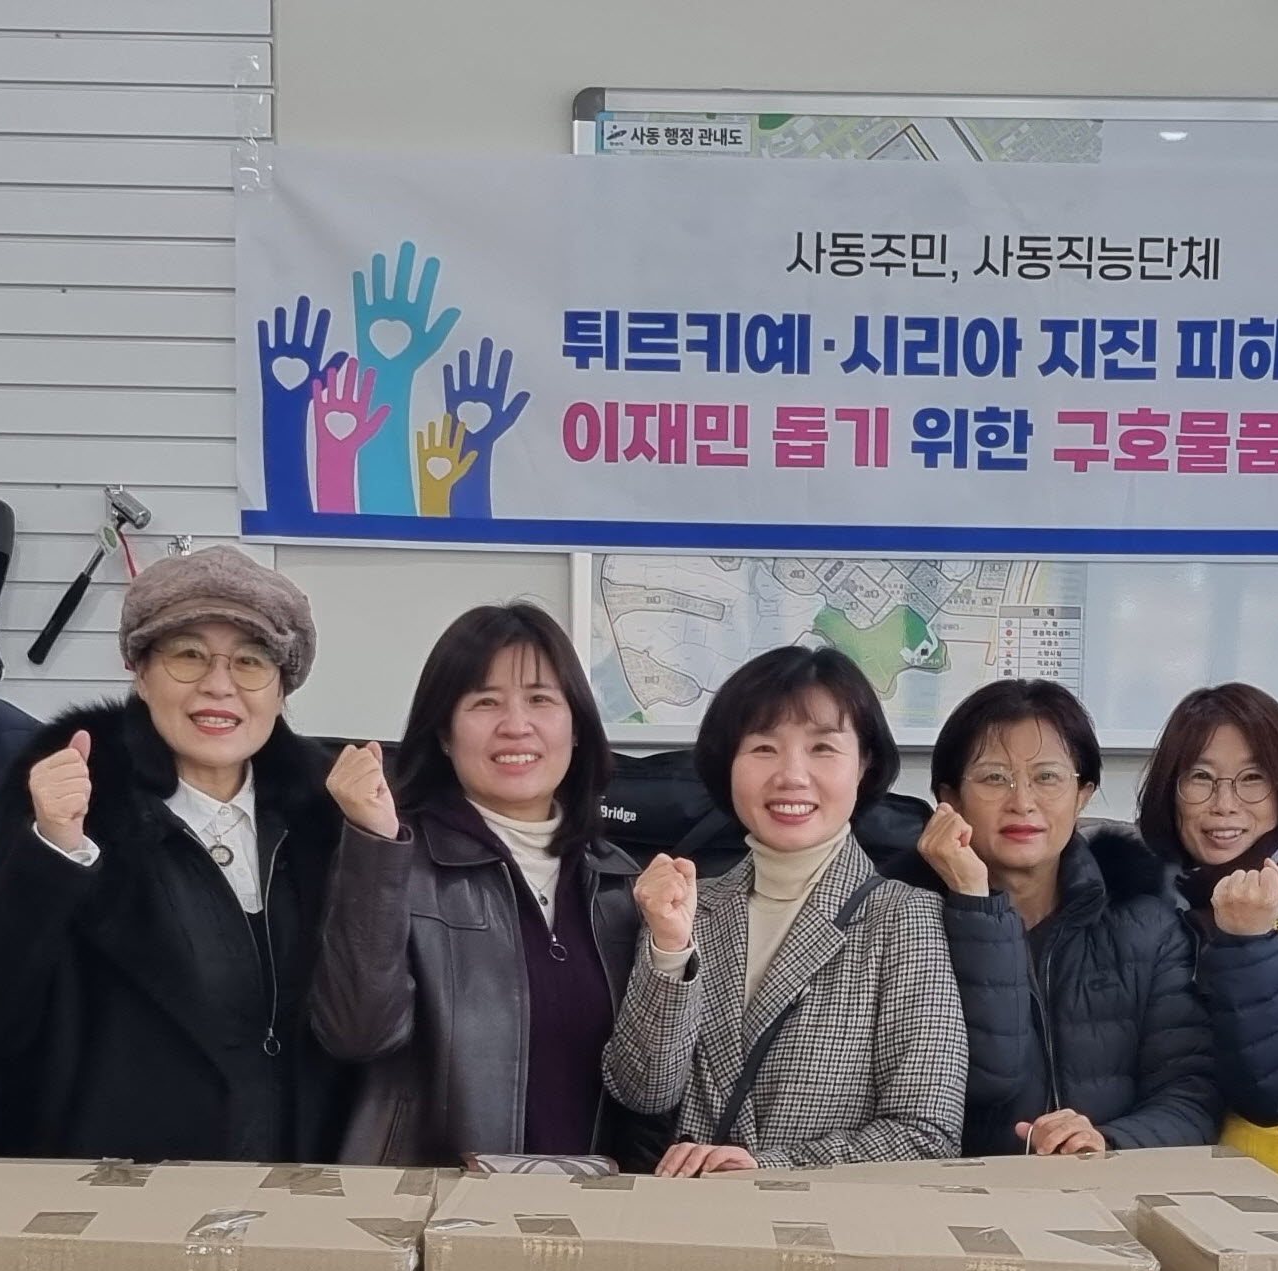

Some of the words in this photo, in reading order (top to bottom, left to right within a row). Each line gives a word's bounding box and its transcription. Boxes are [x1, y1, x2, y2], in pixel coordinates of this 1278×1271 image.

[630, 126, 660, 145] 사동
[664, 127, 694, 145] 행정
[697, 128, 743, 146] 관내도
[785, 231, 959, 284] 사동주민,
[972, 234, 1221, 281] 사동직능단체
[1037, 317, 1157, 381] 지진
[562, 401, 749, 467] 이재민
[772, 406, 890, 469] 돕기
[910, 406, 1034, 472] 위한
